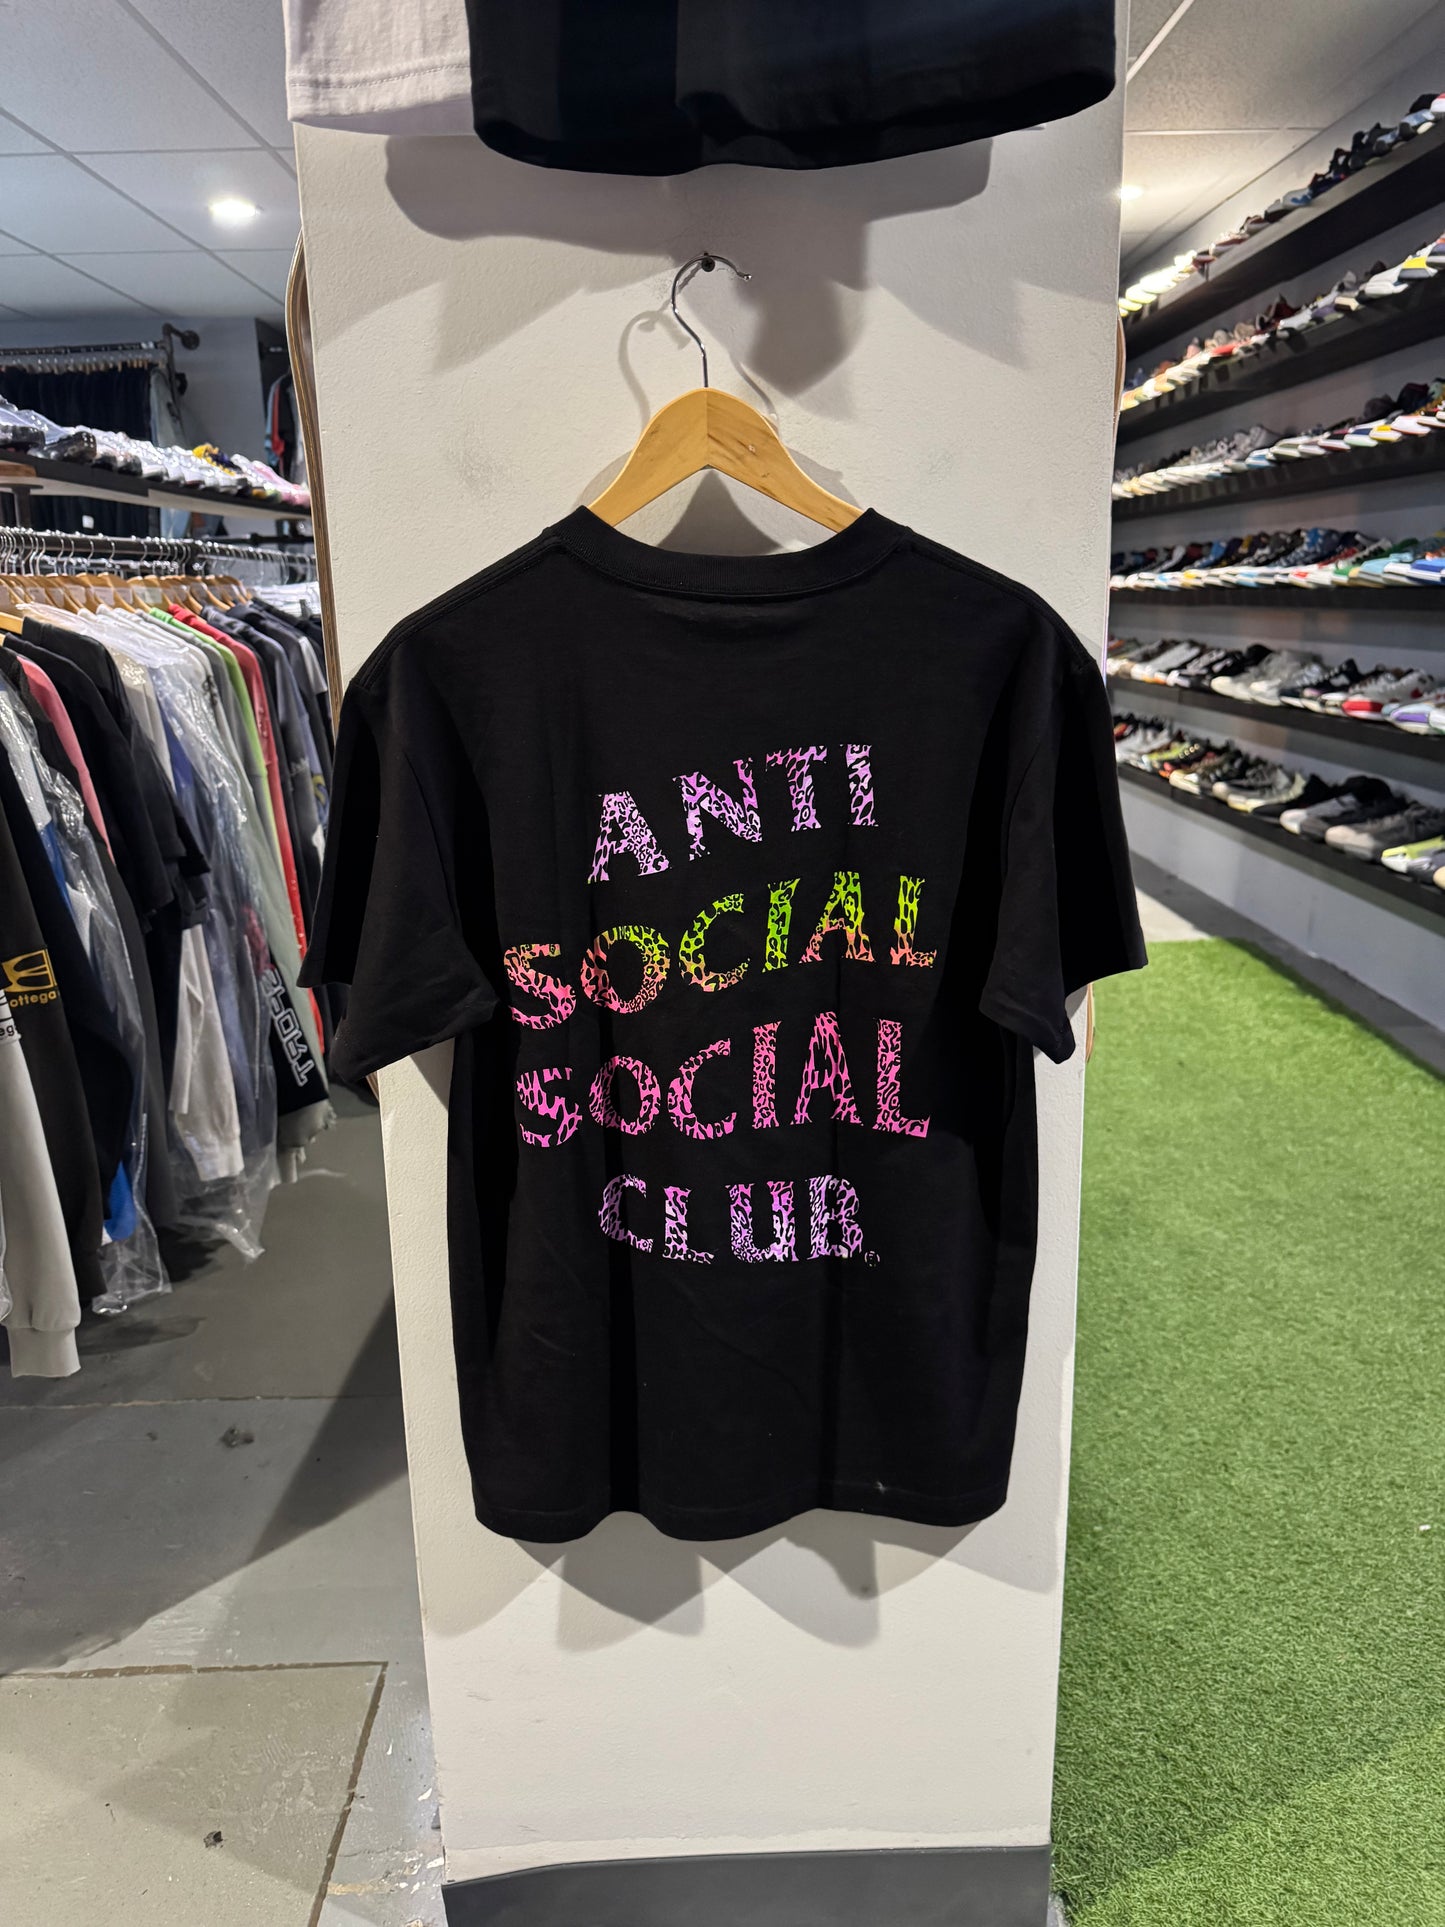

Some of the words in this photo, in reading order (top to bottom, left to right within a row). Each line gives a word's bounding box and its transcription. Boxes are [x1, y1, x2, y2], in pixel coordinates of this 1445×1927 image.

[588, 744, 879, 884] ANTI
[9, 990, 57, 1008] ottega
[504, 871, 937, 1030] SOCIAL
[517, 1011, 931, 1147] SOCIAL
